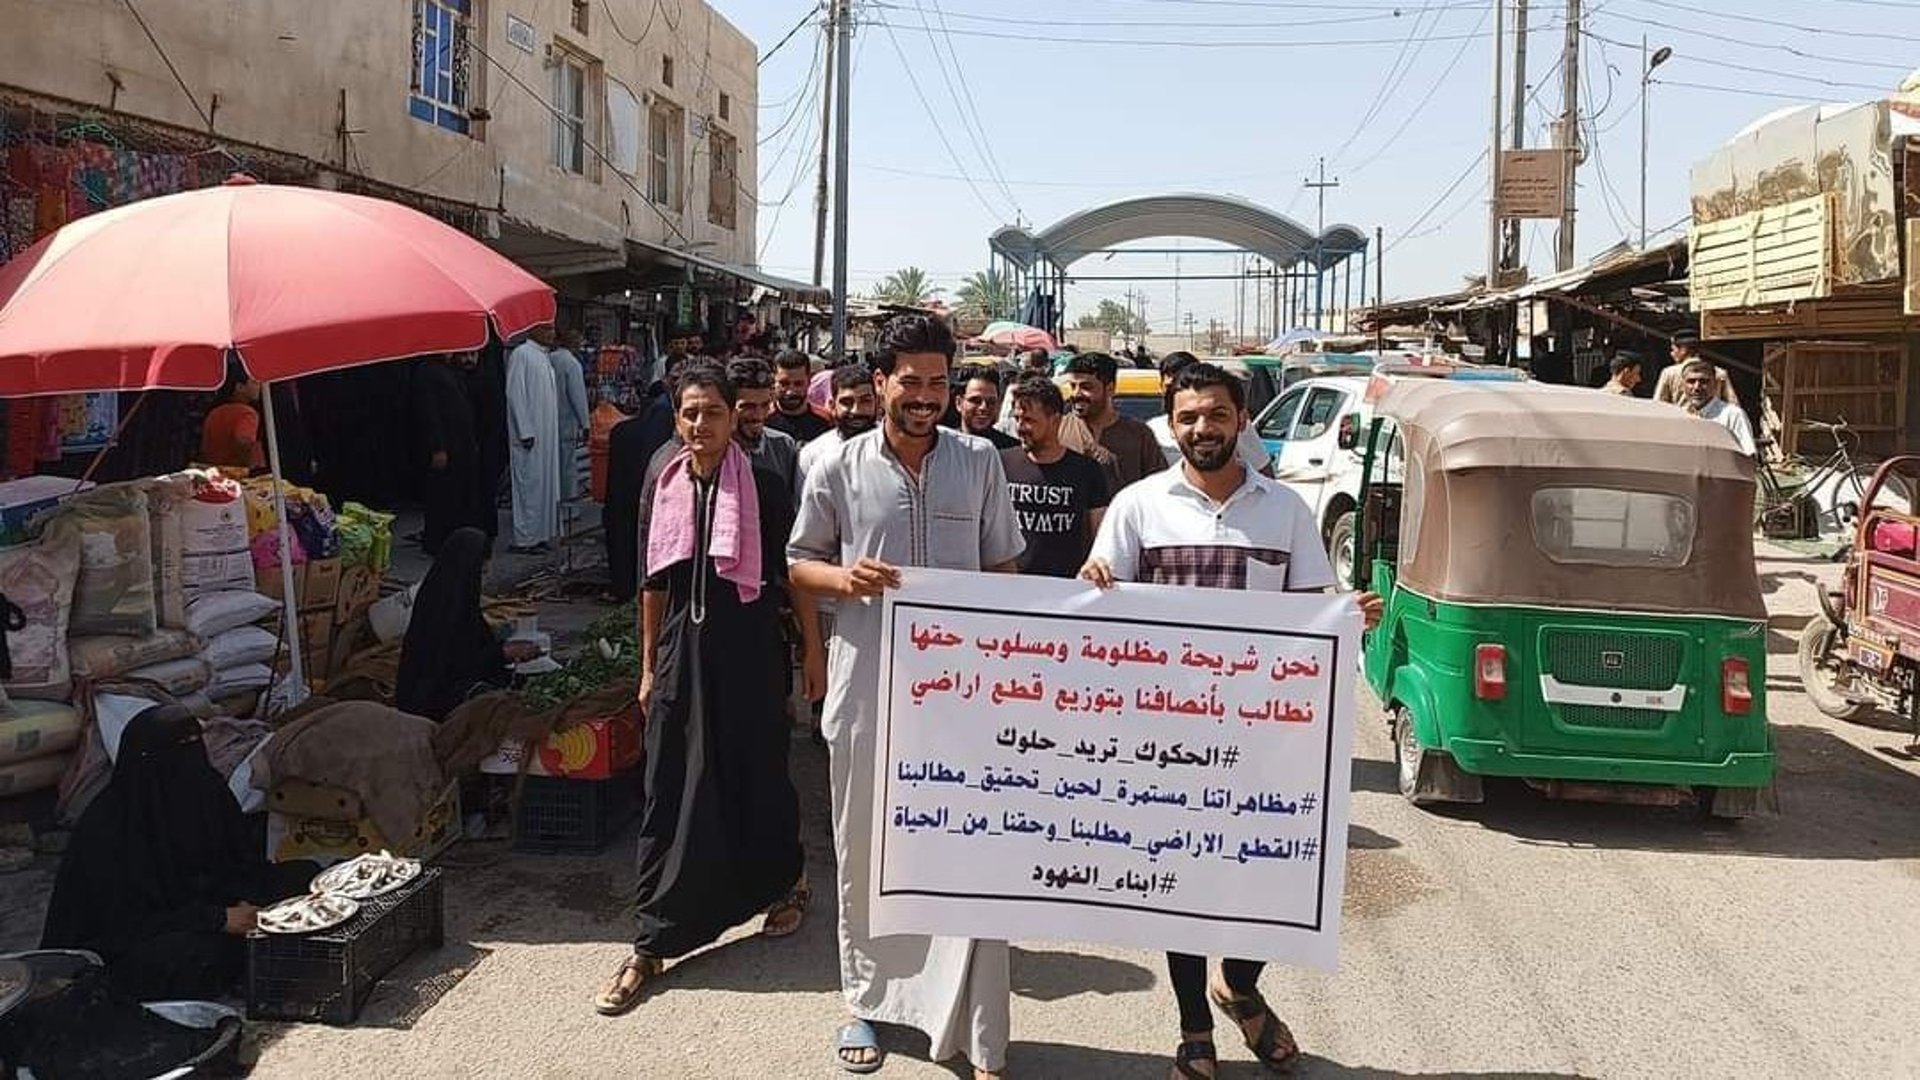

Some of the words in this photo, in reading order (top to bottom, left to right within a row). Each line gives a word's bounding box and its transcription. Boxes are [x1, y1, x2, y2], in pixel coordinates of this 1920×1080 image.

[1009, 483, 1073, 505] TRUST
[911, 622, 963, 651] حقها
[976, 632, 1068, 663] ومسلوب
[1081, 636, 1168, 667] مظلومة
[1181, 643, 1258, 677] شريحة
[1271, 655, 1319, 681] نحن
[911, 670, 980, 705] اراضي
[992, 673, 1043, 705] قطع
[1055, 687, 1123, 715] بتوزيع
[1136, 684, 1225, 724] بأنصافنا
[1238, 700, 1313, 726] نطالب
[995, 726, 1241, 769] #الحكوك_تريد_حلوك
[1032, 864, 1178, 899] #ابناء_الفهود
